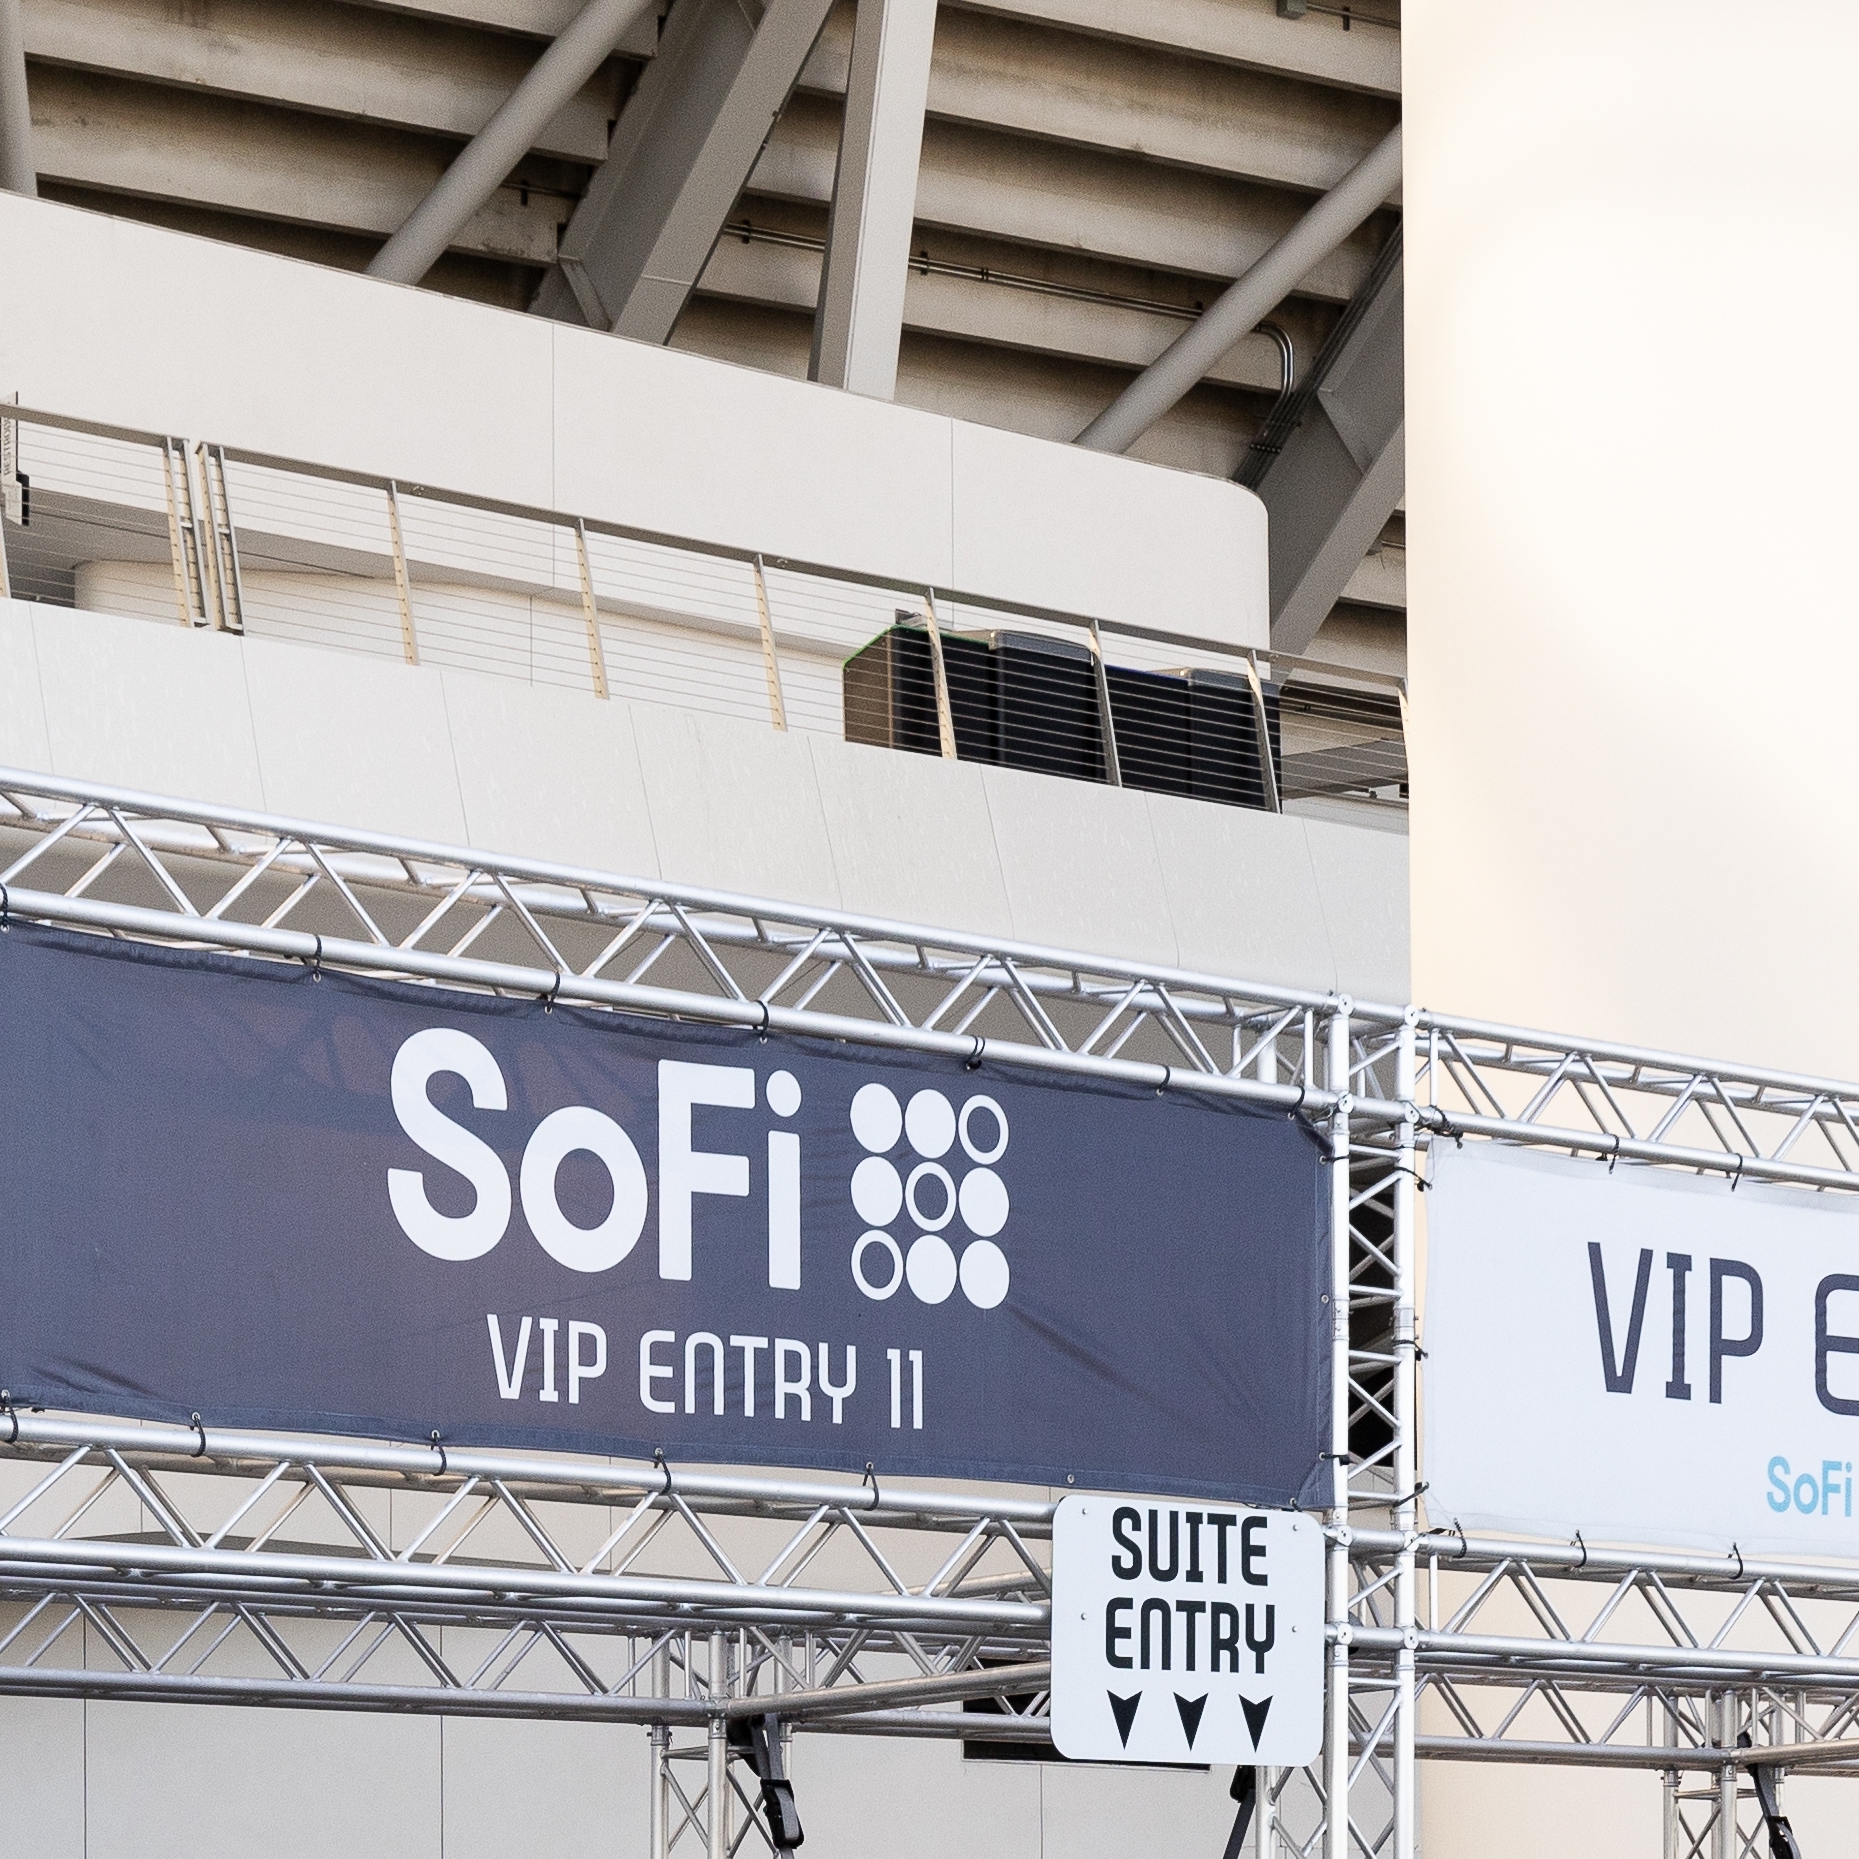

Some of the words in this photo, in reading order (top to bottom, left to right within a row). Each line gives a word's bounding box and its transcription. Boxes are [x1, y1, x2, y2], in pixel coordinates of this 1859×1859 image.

[388, 1028, 802, 1290] SoFi
[487, 1314, 607, 1404] VIP
[640, 1330, 856, 1424] ENTRY
[886, 1349, 923, 1429] 11
[1588, 1242, 1764, 1404] VIP
[1767, 1456, 1853, 1517] SoFi
[1112, 1507, 1268, 1586] SUITE
[1106, 1597, 1275, 1674] ENTRY
